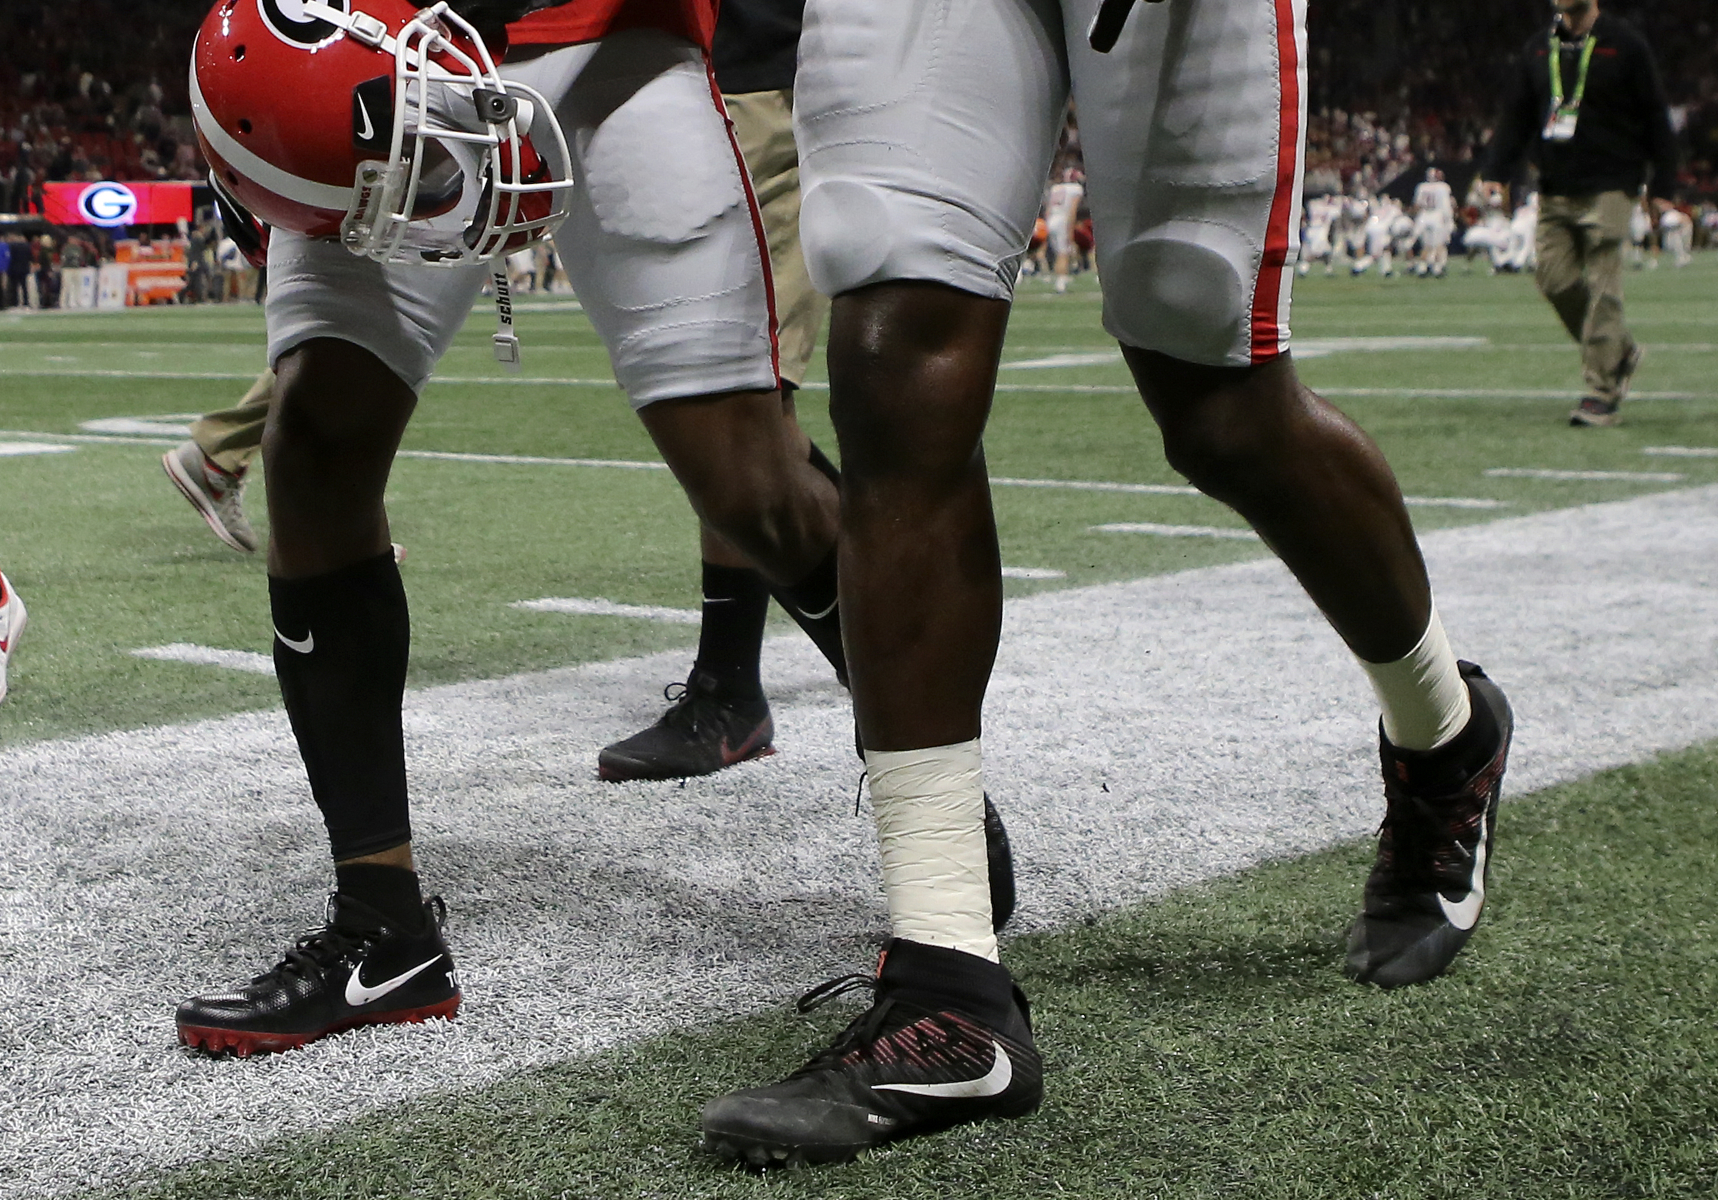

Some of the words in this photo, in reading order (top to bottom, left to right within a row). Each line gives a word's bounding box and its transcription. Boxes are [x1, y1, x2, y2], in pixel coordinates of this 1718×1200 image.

[80, 183, 137, 225] G
[353, 186, 372, 220] DAWGS
[494, 272, 512, 325] schutt
